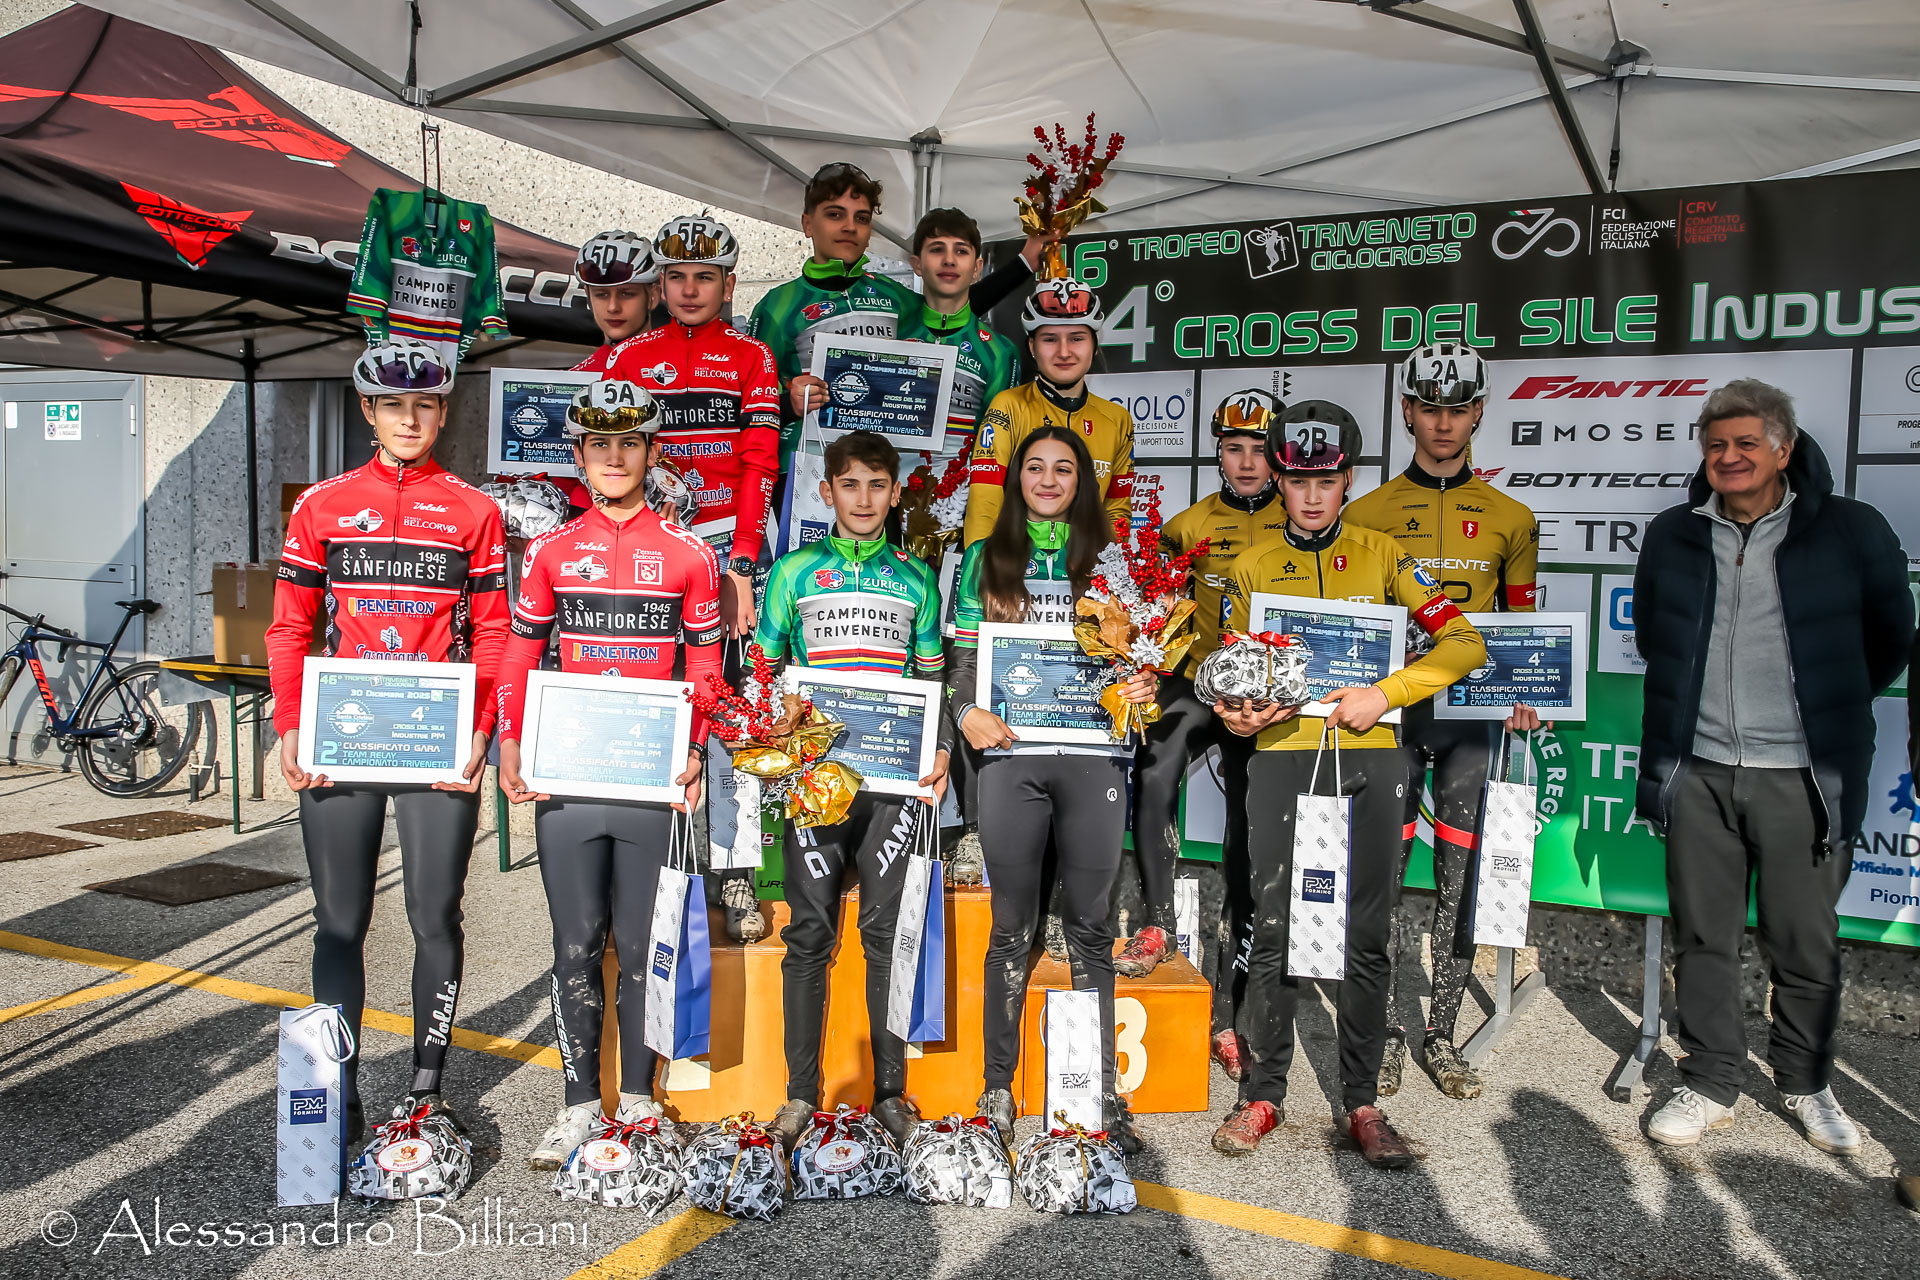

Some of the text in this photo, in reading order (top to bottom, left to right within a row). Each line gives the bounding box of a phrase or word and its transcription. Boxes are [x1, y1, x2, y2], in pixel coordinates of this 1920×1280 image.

[1602, 208, 1626, 220] FCI
[1686, 201, 1717, 214] CRV
[136, 204, 242, 233] BOTTECCHIA
[1685, 215, 1741, 226] COMITATO
[1298, 212, 1477, 249] TRIVENETO
[1601, 219, 1676, 232] FEDERAZIONE
[1684, 222, 1746, 235] REGIONALE
[1600, 230, 1659, 242] CICLISTICA
[1684, 233, 1728, 244] VENETO
[1128, 230, 1241, 261] TROFEO
[1600, 239, 1650, 250] ITALIANA
[1310, 241, 1462, 271] CICLOCROSS
[854, 297, 893, 307] ZURICH
[1173, 308, 1358, 359] CROSS
[1381, 303, 1496, 352] DEL
[1519, 295, 1658, 347] SILE
[827, 348, 846, 359] 46°
[851, 362, 917, 376] 30 2025
[1431, 360, 1459, 386] 2A
[899, 380, 916, 395] 4°
[1508, 375, 1709, 400] FANTIC
[604, 383, 635, 406] 5A
[709, 398, 733, 408] 1945
[914, 403, 926, 411] PM
[838, 408, 895, 420] CLASSIFICATO
[897, 413, 919, 422] GARA
[838, 415, 882, 425] TEAM RELAY
[837, 422, 925, 436] CAMPIONATO TRIVENETO
[1140, 438, 1184, 446] IMPORT TOOLS
[1296, 427, 1328, 457] 2B
[662, 441, 733, 457] PENETRON
[403, 519, 458, 534] BELCORVO
[803, 528, 826, 539] PM
[418, 551, 447, 564] 1945
[342, 560, 447, 581] SANFIORESE
[863, 577, 908, 593] ZURICH
[357, 599, 435, 615] PENETRON
[642, 602, 671, 613] 1945
[564, 610, 670, 630] SANFIORESE
[817, 607, 898, 624] CAMPIONE
[1264, 609, 1286, 620] 46°
[814, 624, 900, 641] TRIVENETO
[1292, 625, 1364, 638] 30 2025
[992, 638, 1013, 649] 46°
[1523, 639, 1545, 647] 2025
[581, 645, 658, 660] PENETRON
[1020, 652, 1031, 660] 30
[1347, 645, 1364, 660] 4°
[1528, 652, 1545, 667] 4°
[320, 674, 343, 686] 46°
[1075, 668, 1092, 683] 4°
[350, 689, 363, 697] 30
[1452, 685, 1470, 705] 3°
[411, 706, 430, 721] 4°
[876, 706, 897, 714] 2025
[1012, 703, 1100, 714] CLASSIFICATO GARA
[1036, 712, 1060, 720] RELAY
[878, 720, 897, 735] 4°
[1011, 718, 1108, 729] CAMPIONATO TRIVENETO
[343, 743, 410, 751] CLASSIFICATO
[414, 745, 440, 753] GARA
[896, 745, 910, 753] PM
[342, 758, 448, 768] CAMPIONATO TRIVENETO
[563, 755, 656, 770] CLASSIFICATO GARA
[878, 756, 902, 765] GARA
[561, 773, 664, 786] CAMPIONATO TRIVENETO
[865, 769, 909, 780] TRIVENETO
[1493, 856, 1521, 868] PM
[1493, 865, 1519, 873] PROFILES
[1304, 877, 1333, 890] PM
[293, 1097, 325, 1110] PM
